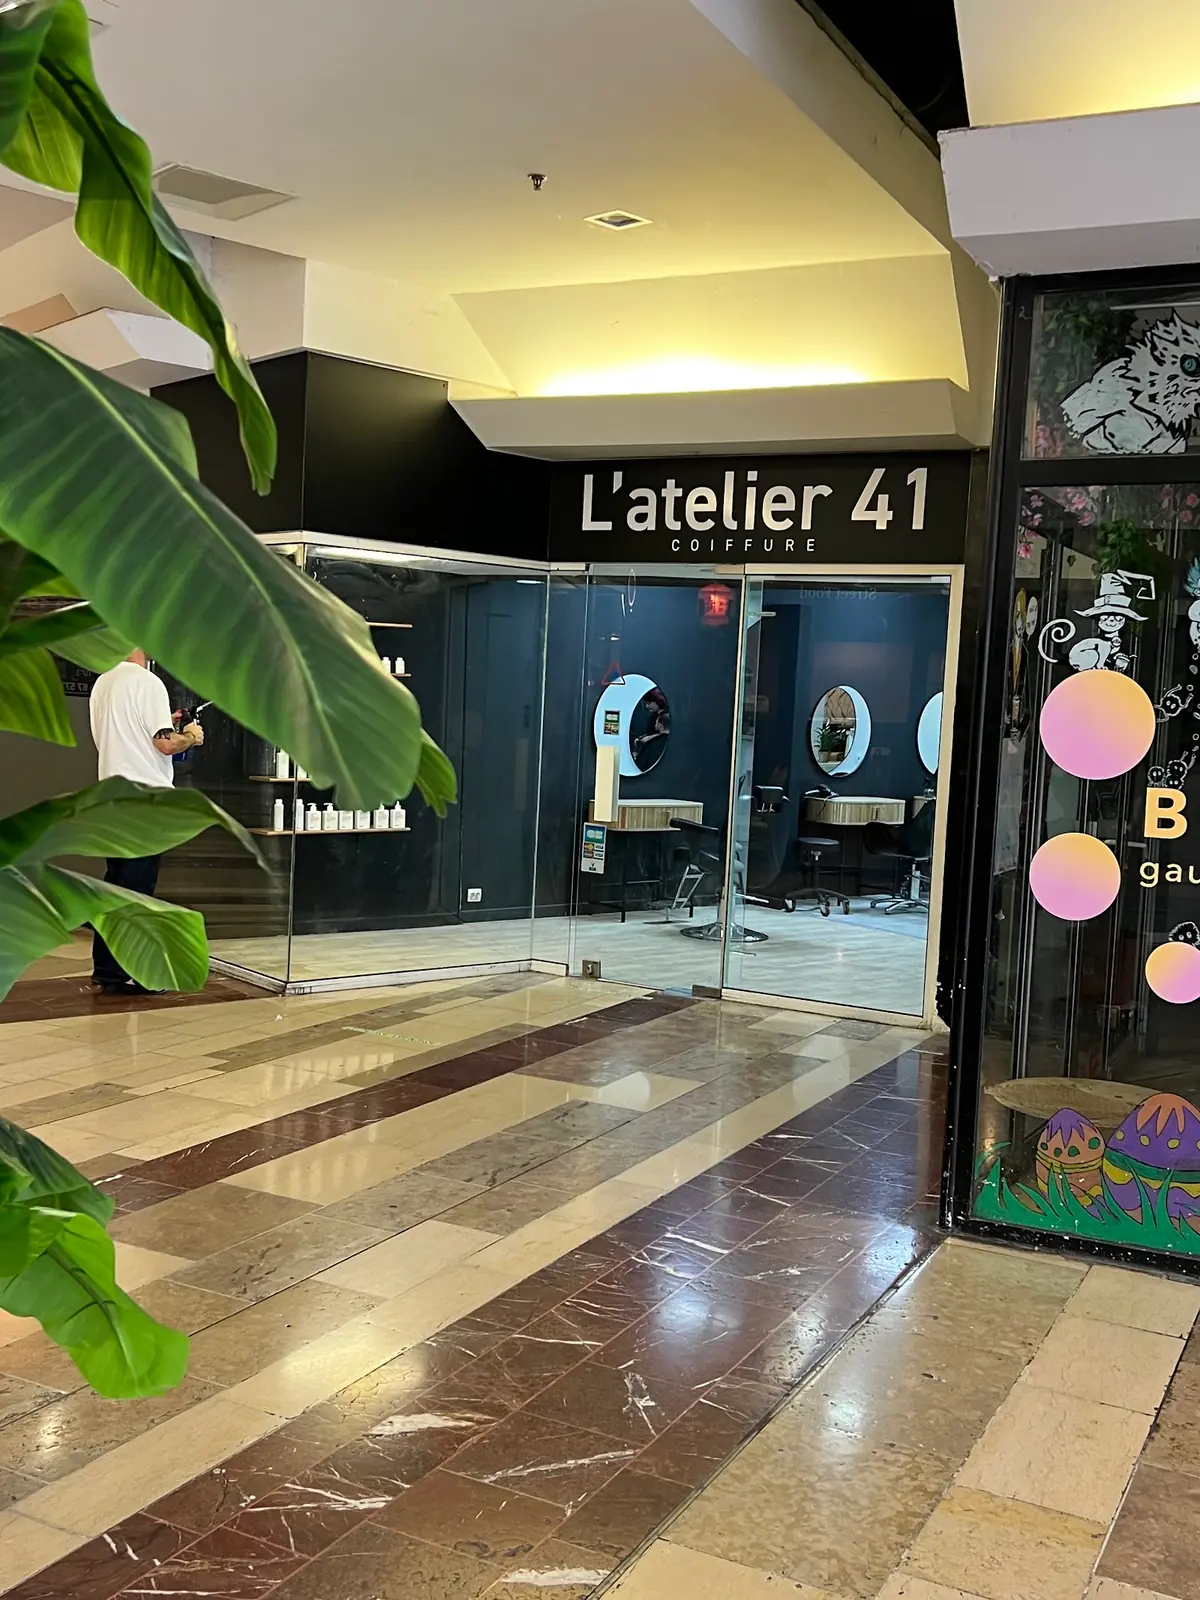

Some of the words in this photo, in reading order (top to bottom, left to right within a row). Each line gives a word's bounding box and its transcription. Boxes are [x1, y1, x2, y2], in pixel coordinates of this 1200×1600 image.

[581, 470, 834, 532] L'atelier
[850, 467, 928, 530] 41
[671, 538, 816, 552] COIFFURE
[1144, 787, 1188, 839] B
